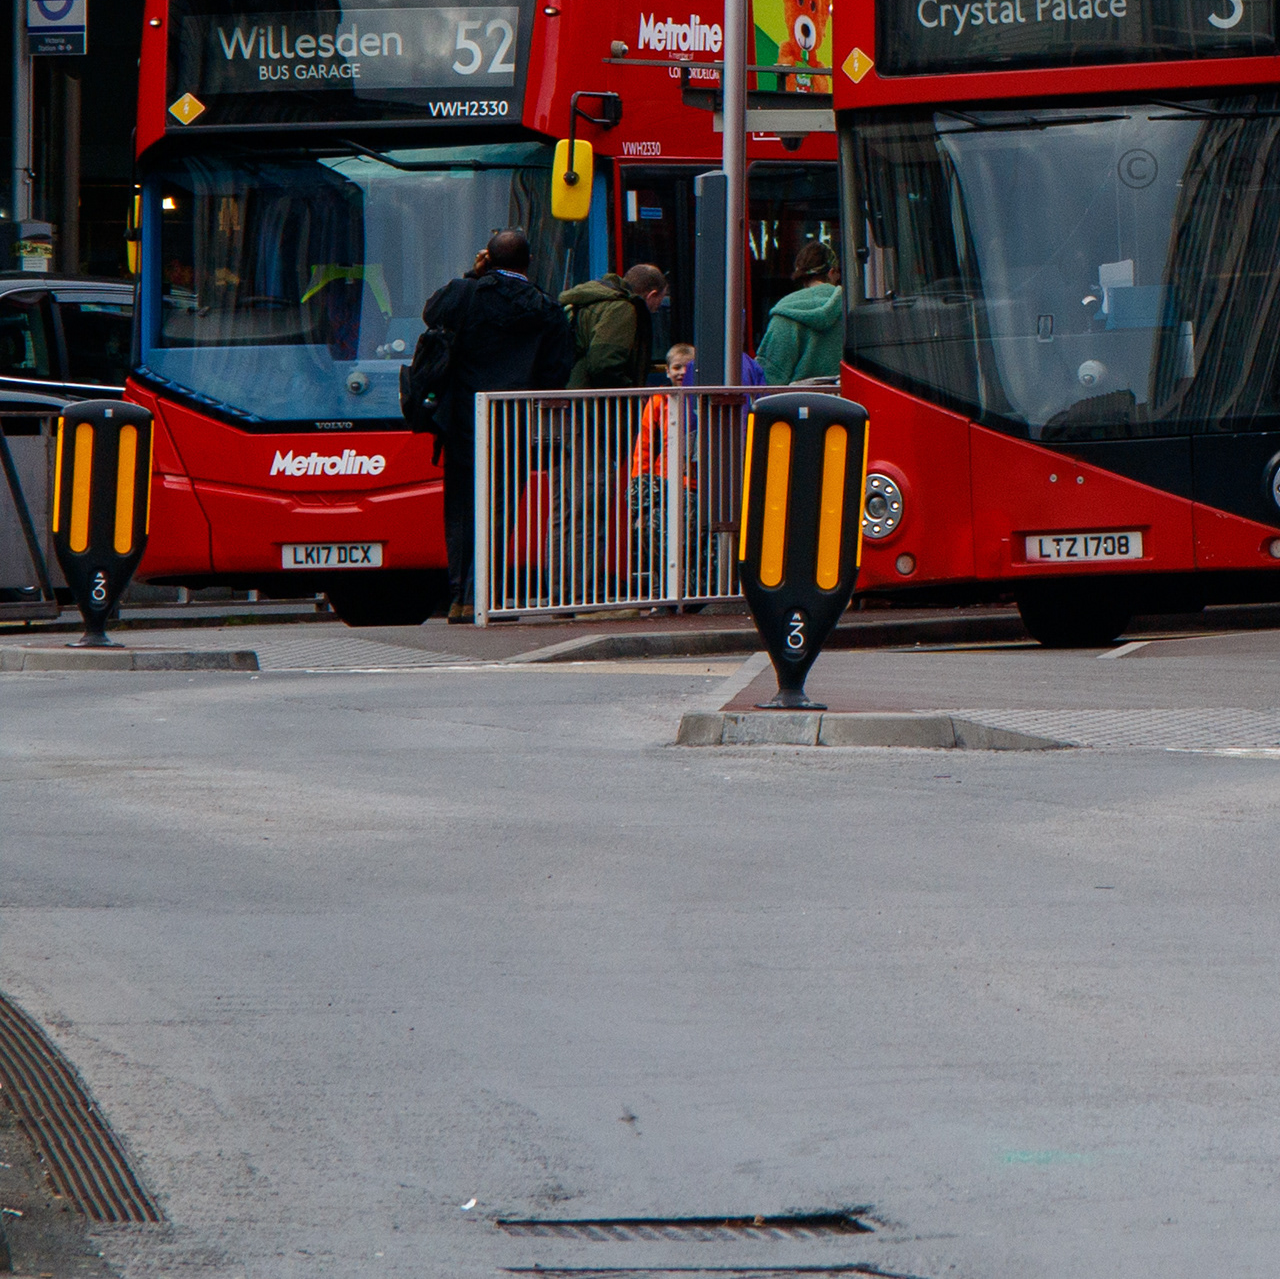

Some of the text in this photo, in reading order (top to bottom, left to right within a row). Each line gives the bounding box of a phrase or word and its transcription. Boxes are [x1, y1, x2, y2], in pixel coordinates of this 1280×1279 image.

[638, 12, 723, 52] Metroline
[217, 19, 516, 76] Willesden 52
[258, 63, 361, 81] BUS GARAGE
[428, 100, 509, 117] VWH2330
[622, 141, 661, 156] VWH2330
[315, 421, 353, 430] VOLVO
[269, 449, 386, 476] Metroline
[293, 545, 372, 565] LK17 DCX
[1037, 534, 1131, 559] LTZ 1708
[787, 622, 804, 649] 3
